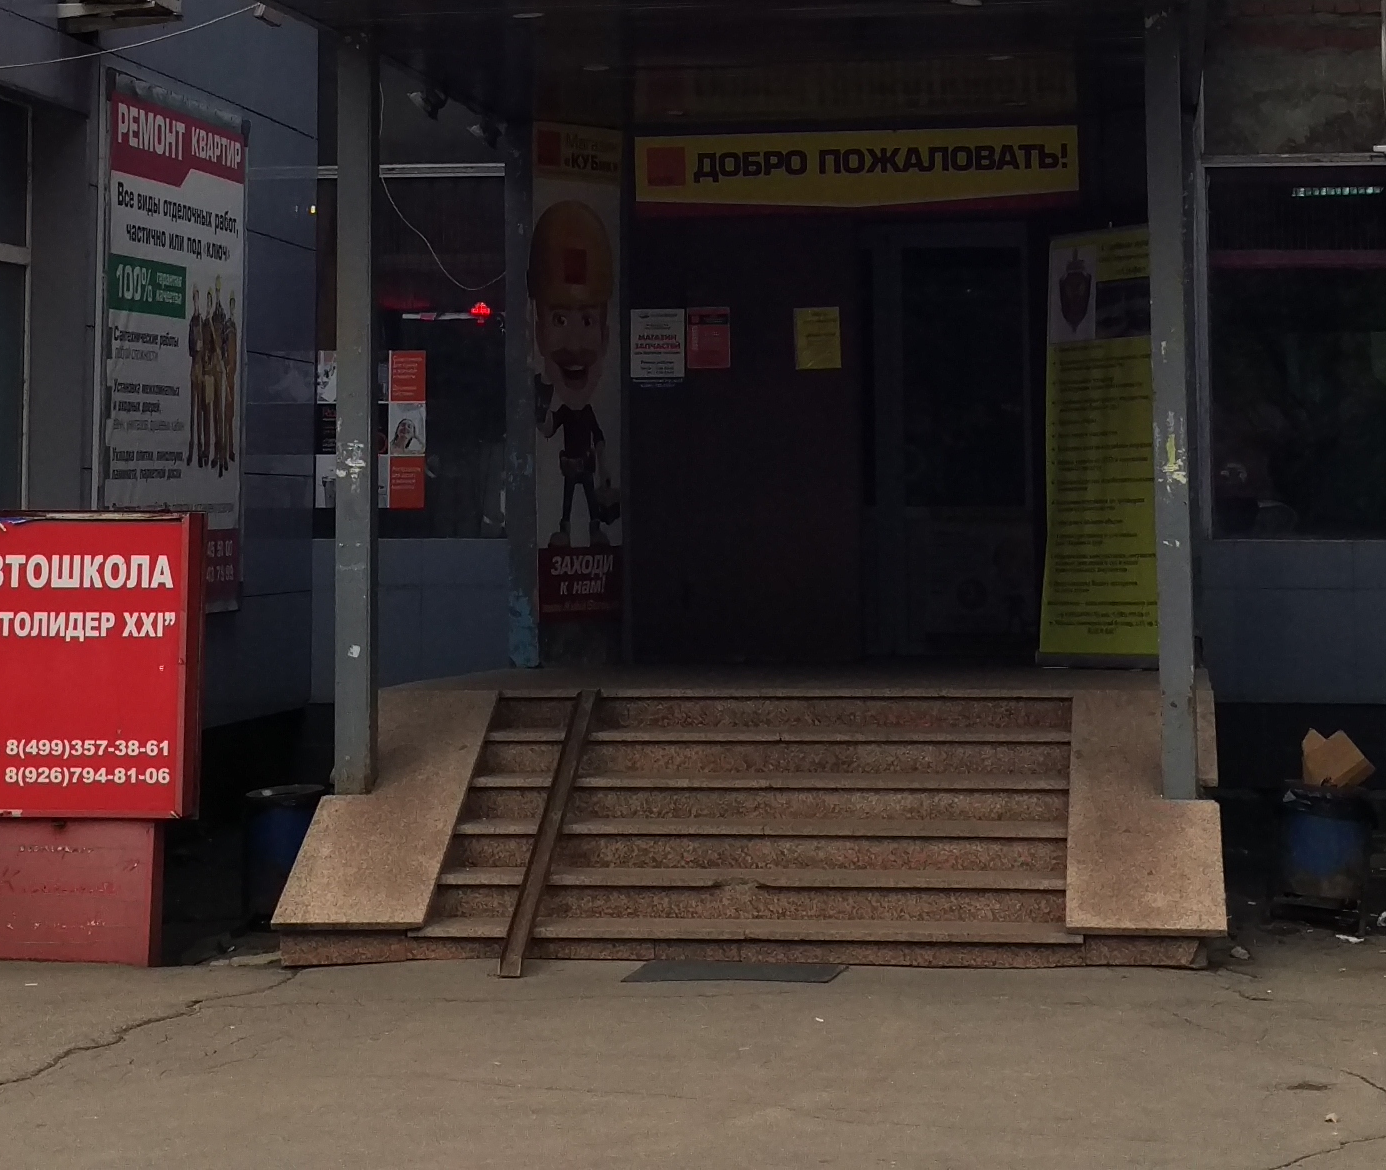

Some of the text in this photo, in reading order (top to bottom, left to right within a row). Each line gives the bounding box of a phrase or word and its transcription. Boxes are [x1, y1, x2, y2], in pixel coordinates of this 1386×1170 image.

[117, 102, 242, 170] РЕМОНТ КВАРТИР
[693, 143, 1069, 184] ДОБРО ПОЖАЛОВАТЬ!
[117, 181, 239, 238] Все виды отделочных работ,
[126, 223, 166, 248] частично
[169, 232, 185, 252] или
[186, 237, 203, 259] под
[116, 263, 153, 302] 100%
[550, 554, 614, 578] ЗАХОДИ
[5, 738, 169, 759] 8(499)357-38-61
[5, 766, 170, 787] 8(926)794-81-06
